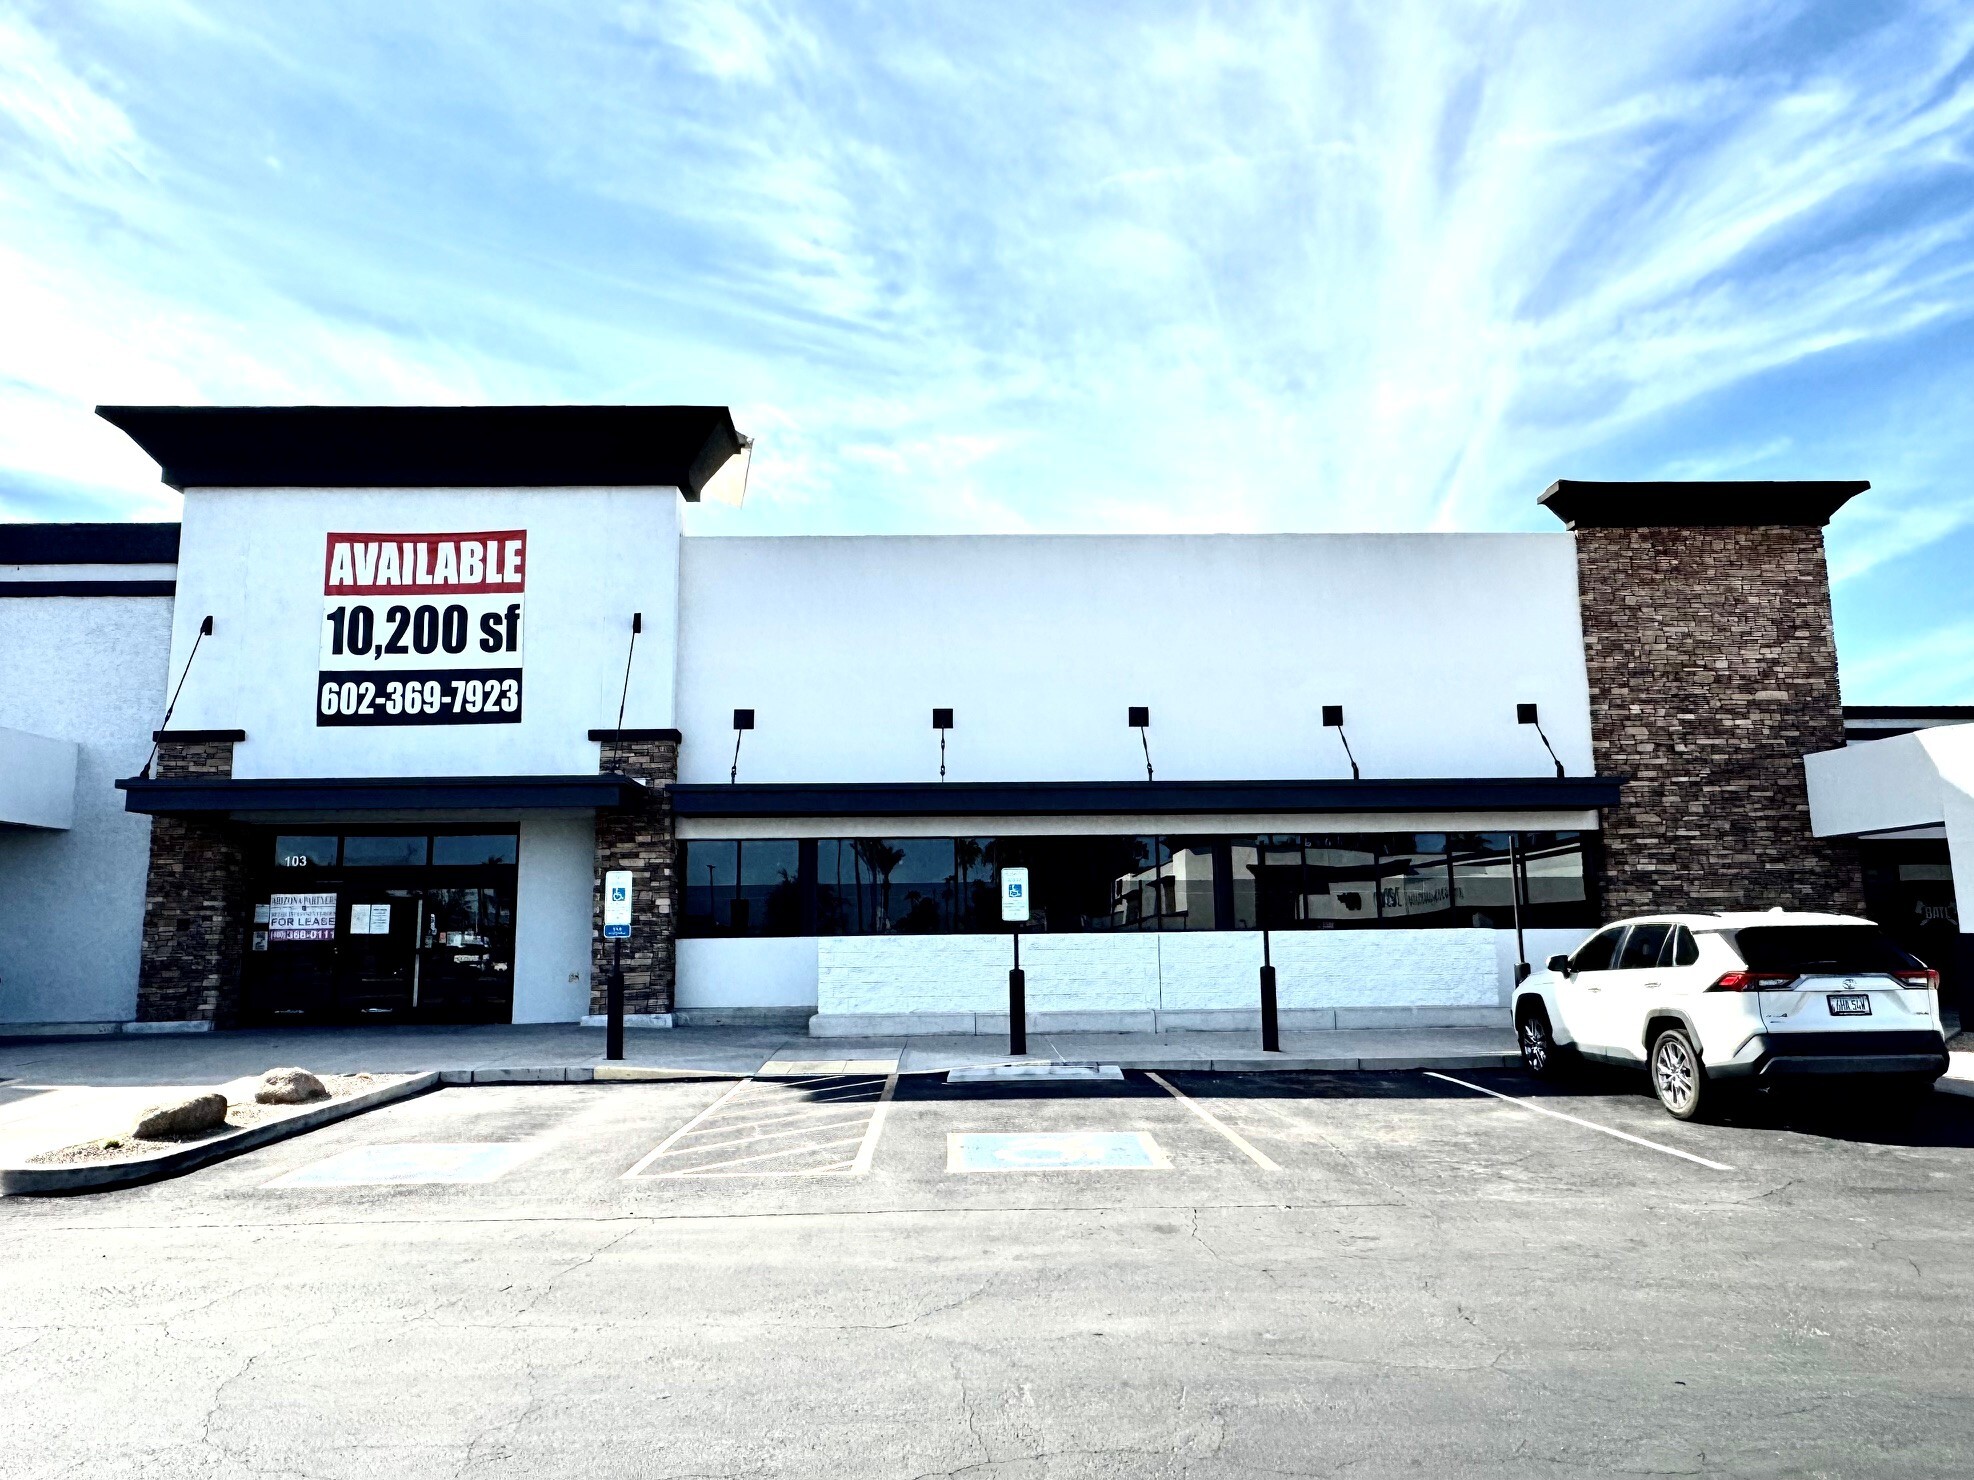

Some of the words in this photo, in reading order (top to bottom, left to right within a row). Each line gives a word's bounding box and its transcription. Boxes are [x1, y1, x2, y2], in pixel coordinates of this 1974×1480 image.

[328, 540, 522, 585] AVAILABLE
[327, 604, 469, 660] 10,200
[479, 604, 521, 652] sf
[320, 679, 519, 715] 602-369-7923
[284, 856, 307, 867] 103
[271, 918, 294, 926] FOR
[298, 917, 335, 926] LEASE
